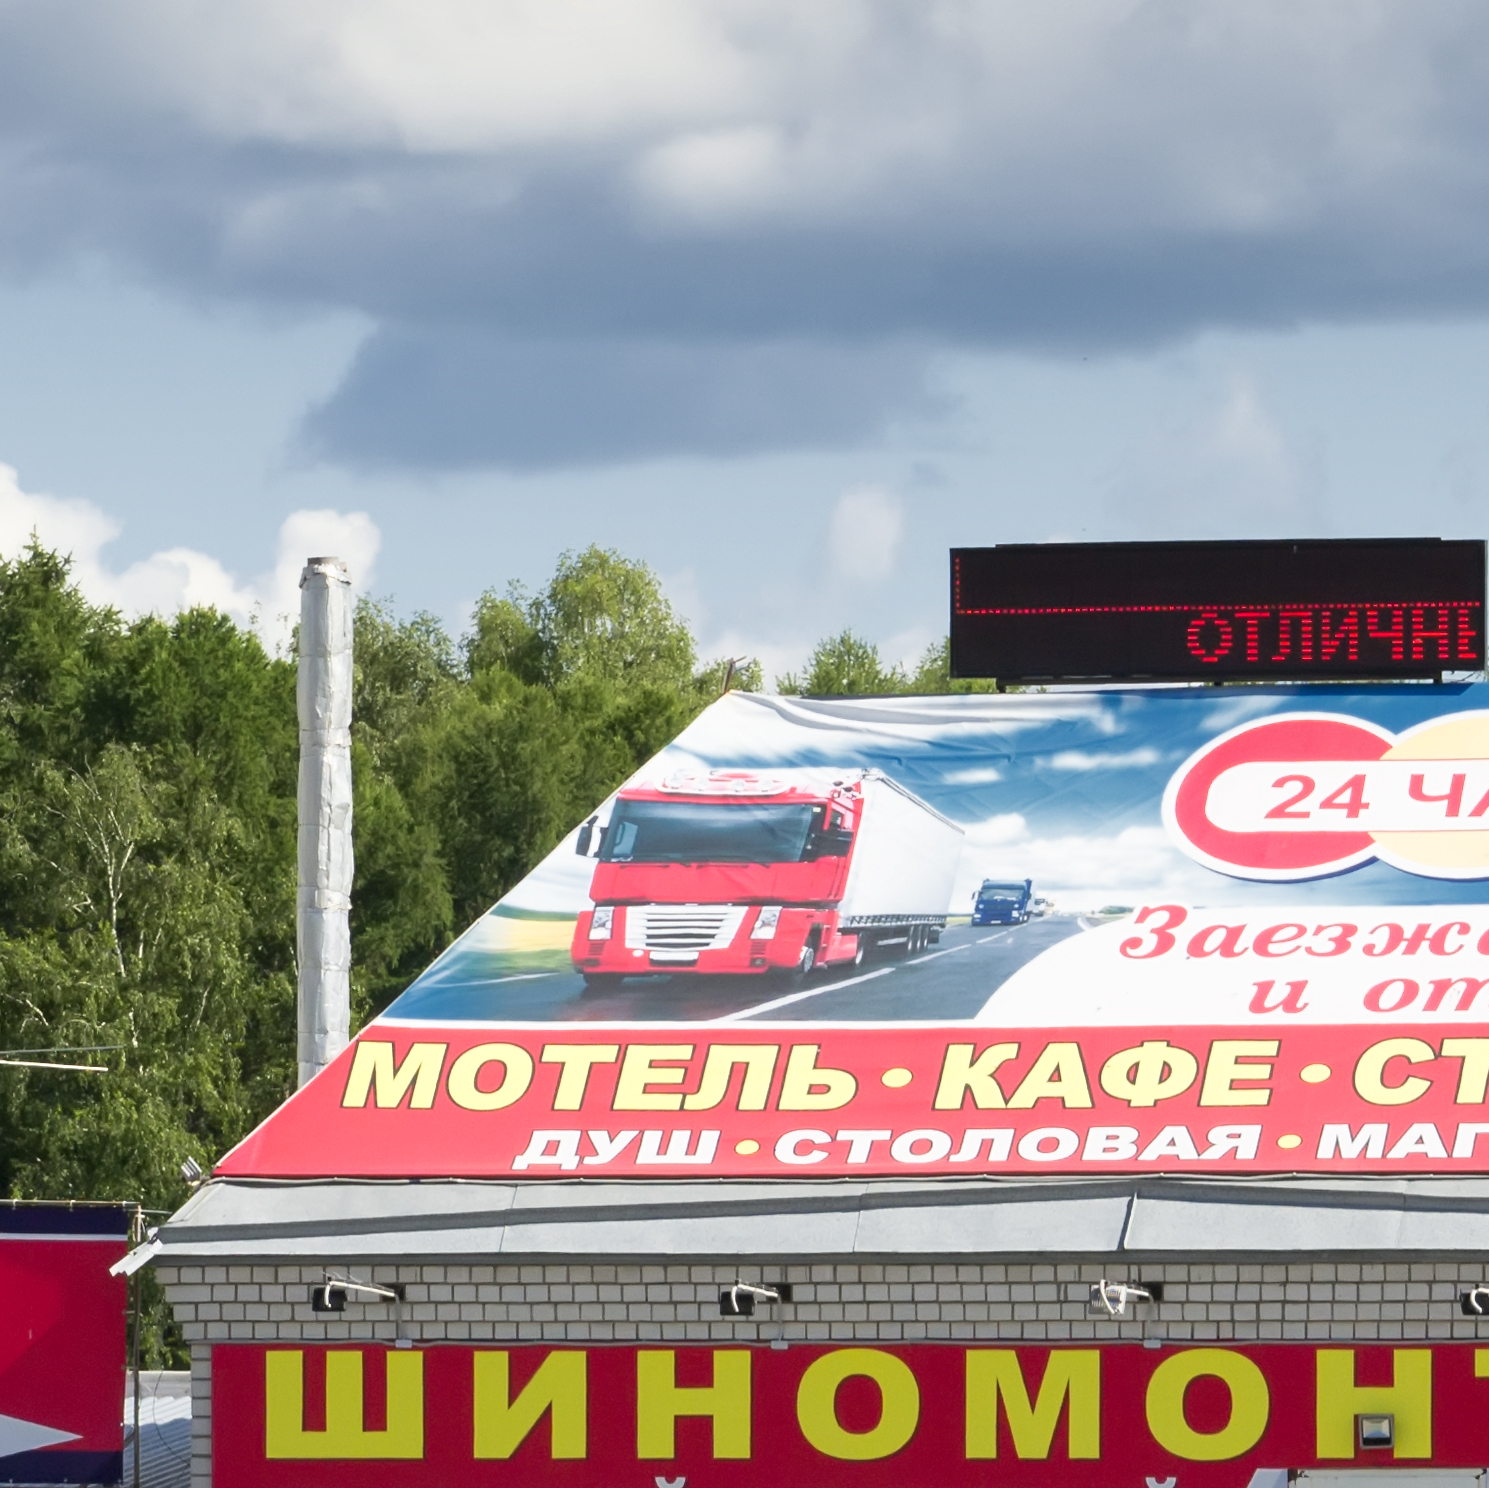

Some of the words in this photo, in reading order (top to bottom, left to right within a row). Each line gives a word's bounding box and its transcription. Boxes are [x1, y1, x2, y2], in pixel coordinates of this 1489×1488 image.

[1264, 773, 1370, 820] 24
[1249, 975, 1308, 1016] и
[340, 1040, 860, 1113] МОТЕЛЬ
[932, 1037, 1282, 1113] КАФЕ
[512, 1128, 721, 1171] ДУШ
[772, 1122, 1261, 1167] СТОЛОВАЯ
